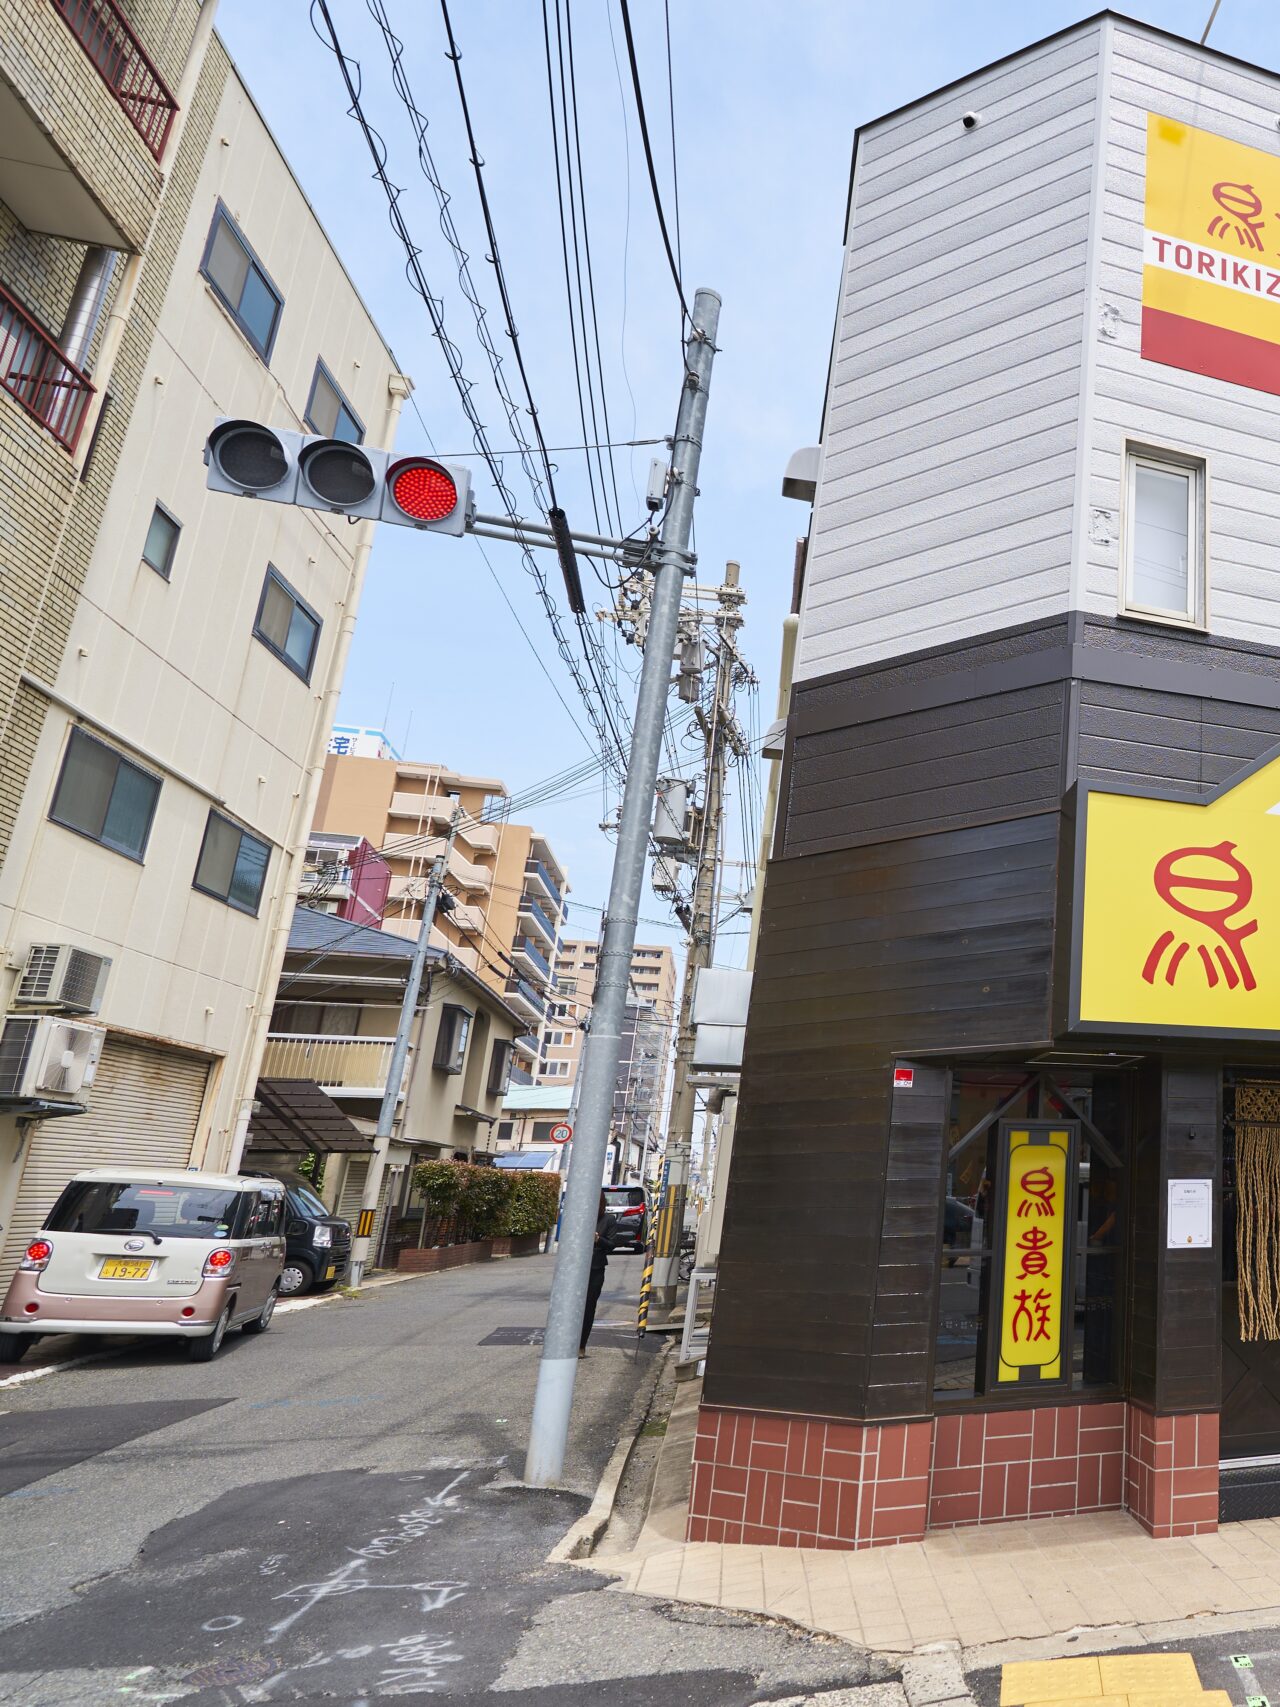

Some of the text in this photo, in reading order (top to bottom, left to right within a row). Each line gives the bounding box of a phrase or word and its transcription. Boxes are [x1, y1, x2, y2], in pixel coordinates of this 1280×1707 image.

[555, 1129, 569, 1139] 20
[1012, 1167, 1056, 1343] 鳥貴族
[111, 1266, 149, 1278] 19-77
